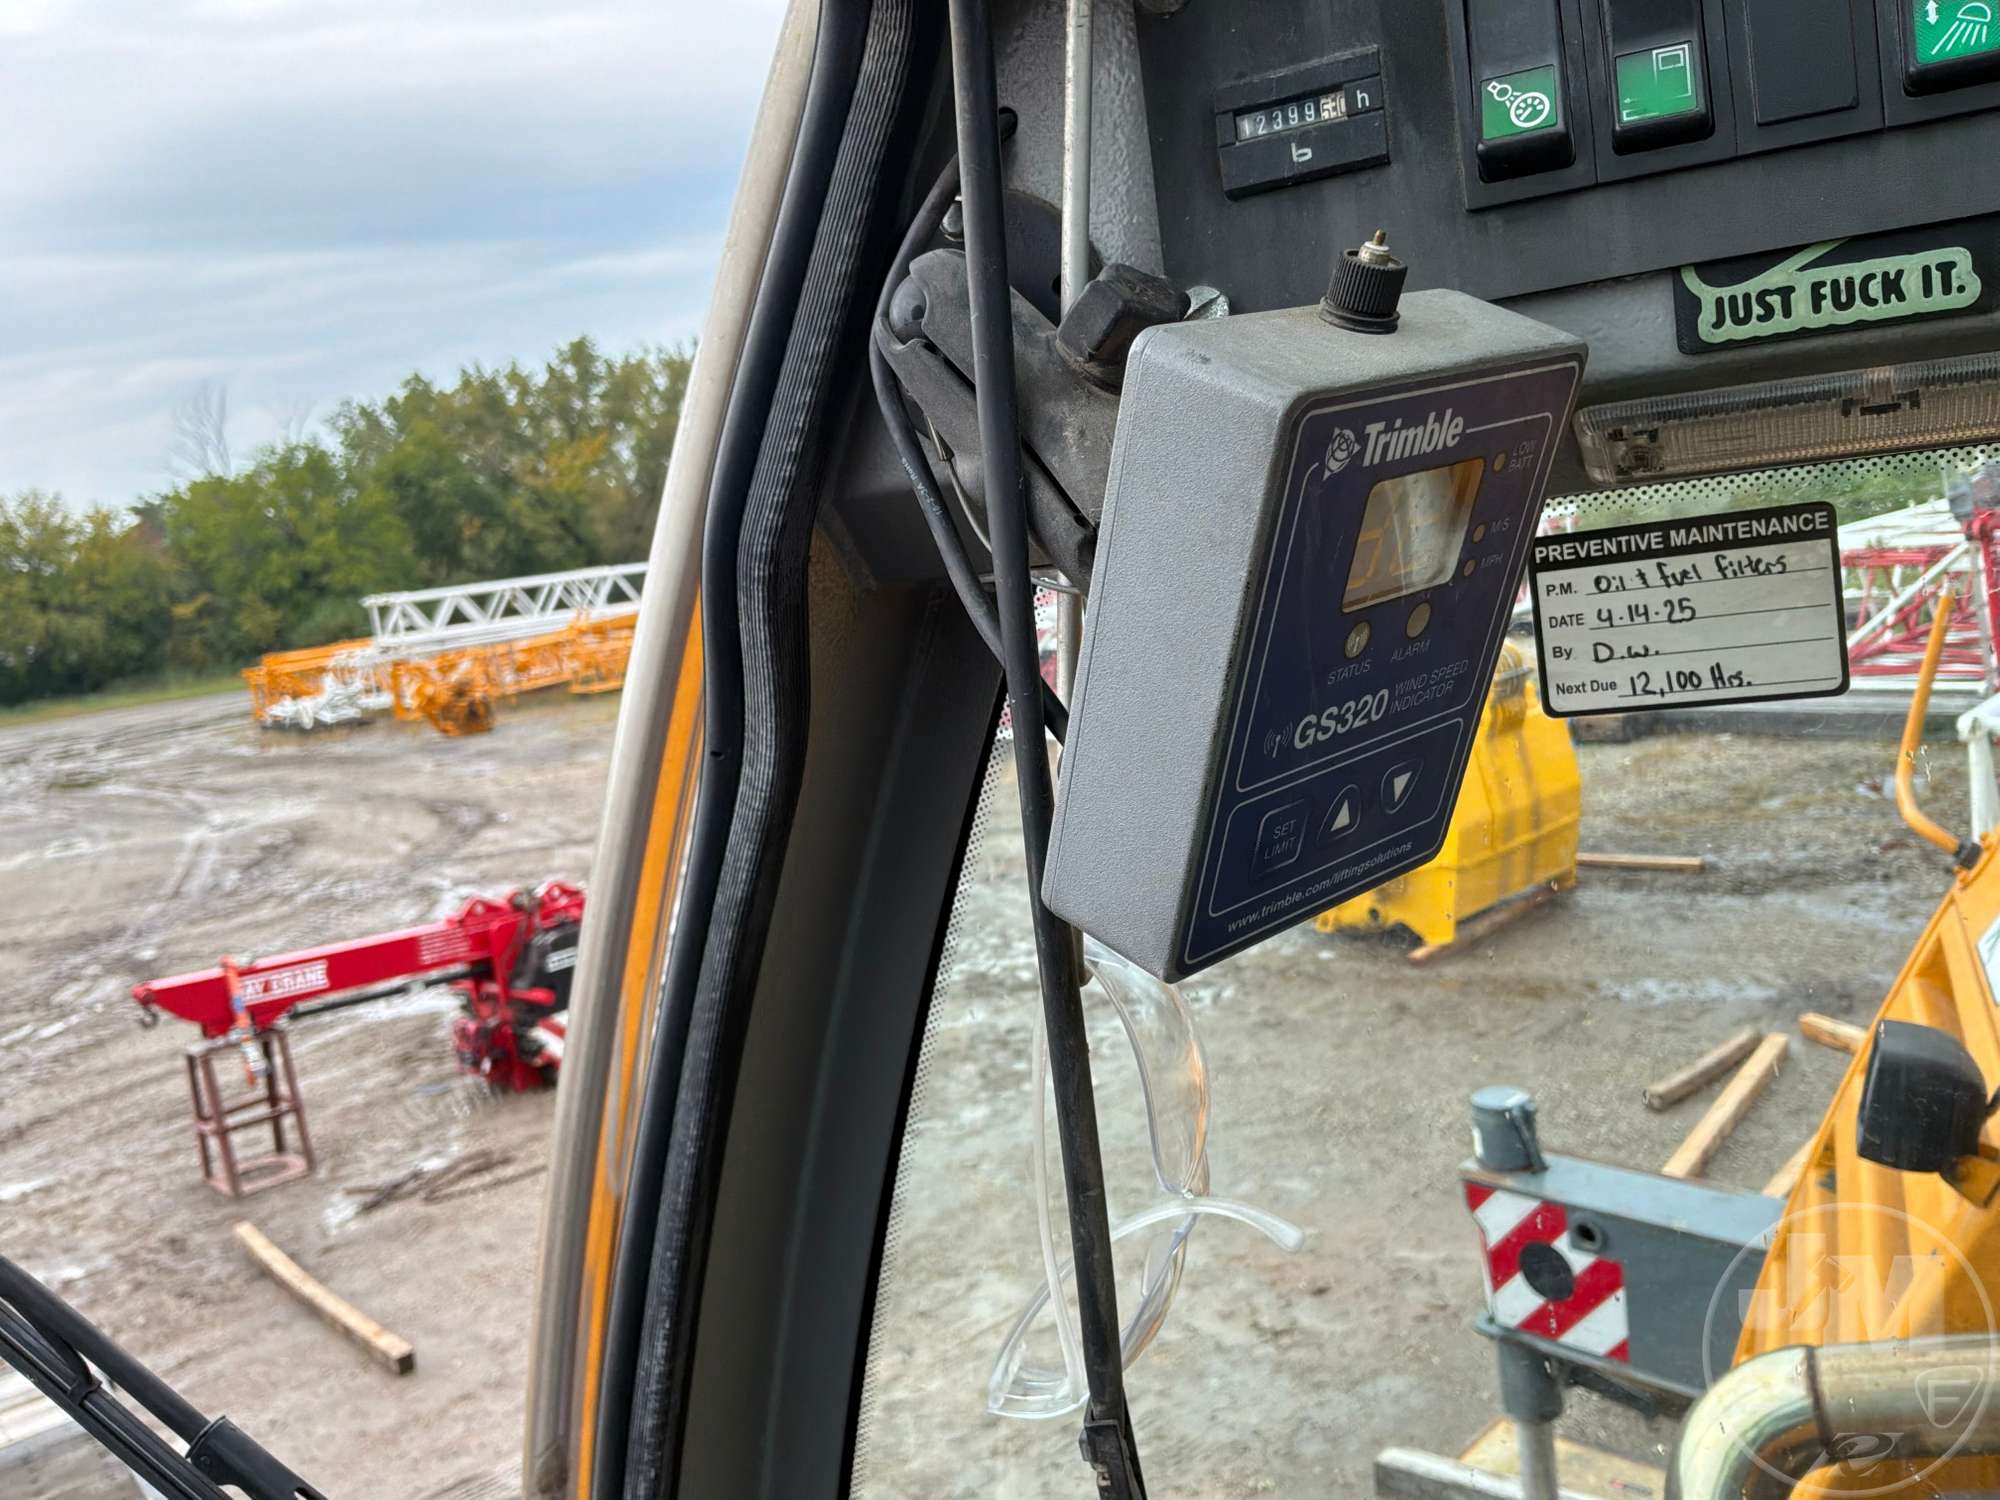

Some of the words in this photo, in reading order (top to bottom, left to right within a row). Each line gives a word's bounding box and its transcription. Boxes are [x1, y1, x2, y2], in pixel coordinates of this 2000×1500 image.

[1711, 284, 1796, 330] JUST
[1810, 268, 1907, 315] FUCK
[1920, 260, 1967, 299] IT.
[1362, 408, 1465, 468] Trimble
[1534, 531, 1665, 564] PREVENTIVE
[1669, 511, 1830, 548] MAINTENANCE
[1545, 583, 1578, 598] P.M.
[1593, 574, 1627, 594] Oil
[1548, 613, 1585, 629] DATE
[1389, 639, 1431, 662] ALARM
[1551, 646, 1573, 661] By
[1327, 659, 1372, 685] STATUS
[1389, 680, 1455, 712] INDICATOR
[1555, 681, 1587, 696] Next
[1590, 679, 1618, 692] Due
[1293, 688, 1389, 749] GS320
[1394, 673, 1428, 697] WIND
[1428, 659, 1469, 685] SPEED
[1272, 819, 1297, 840] SET
[1264, 836, 1297, 861] LIMIT
[1227, 841, 1413, 933] www.trimble.com/liftingsolutions
